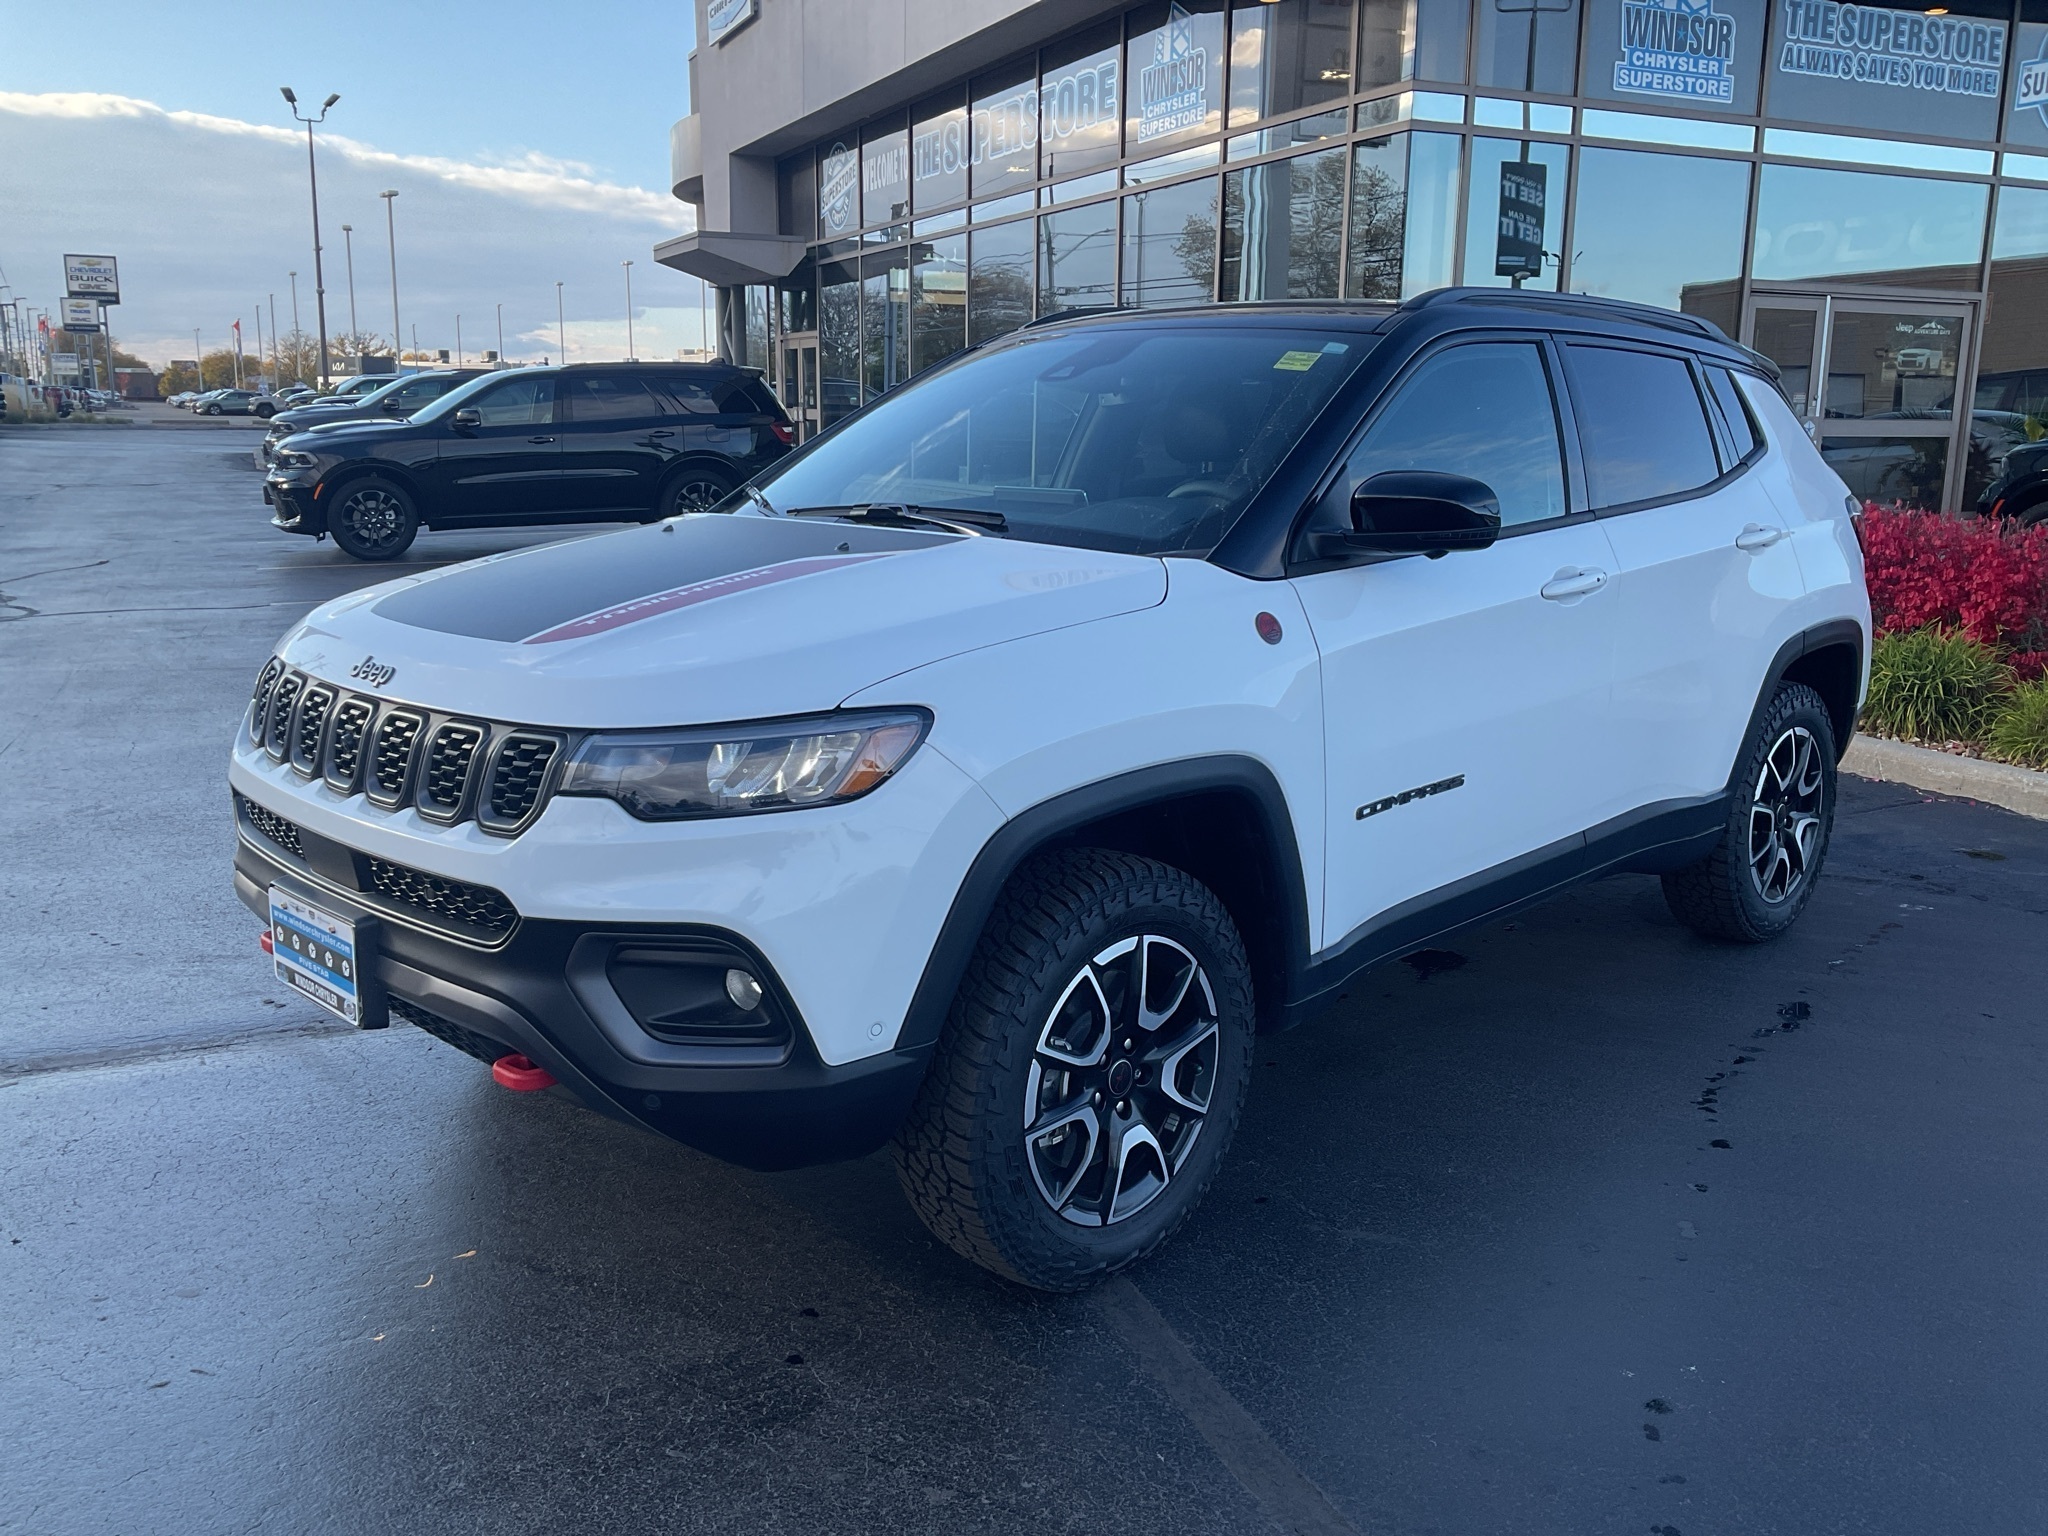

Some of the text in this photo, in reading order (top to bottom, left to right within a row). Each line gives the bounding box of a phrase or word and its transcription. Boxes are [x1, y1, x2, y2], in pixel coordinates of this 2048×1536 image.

[1625, 6, 1732, 59] WINDSOR
[1787, 1, 2004, 65] THE SUPERSTORE
[1142, 51, 1204, 105] WINDSOR
[1619, 69, 1730, 96] SUPERSTORE
[1632, 51, 1719, 75] CHRYSLER
[1783, 45, 1998, 95] ALWAYS SAVES YOU MORE!
[2021, 71, 2048, 97] SU
[1140, 107, 1203, 137] SUPERSTORE
[1147, 92, 1197, 118] CHRYSLER
[862, 59, 1118, 193] WELCOME TO THE SUPERSTORE
[822, 163, 856, 210] SUPERSTORE
[1896, 322, 1913, 333] Jeep
[573, 568, 775, 627] TRAILHAWK
[350, 654, 397, 688] Jeep
[1355, 773, 1465, 820] COMPASS
[298, 956, 330, 980] FIVE STAR
